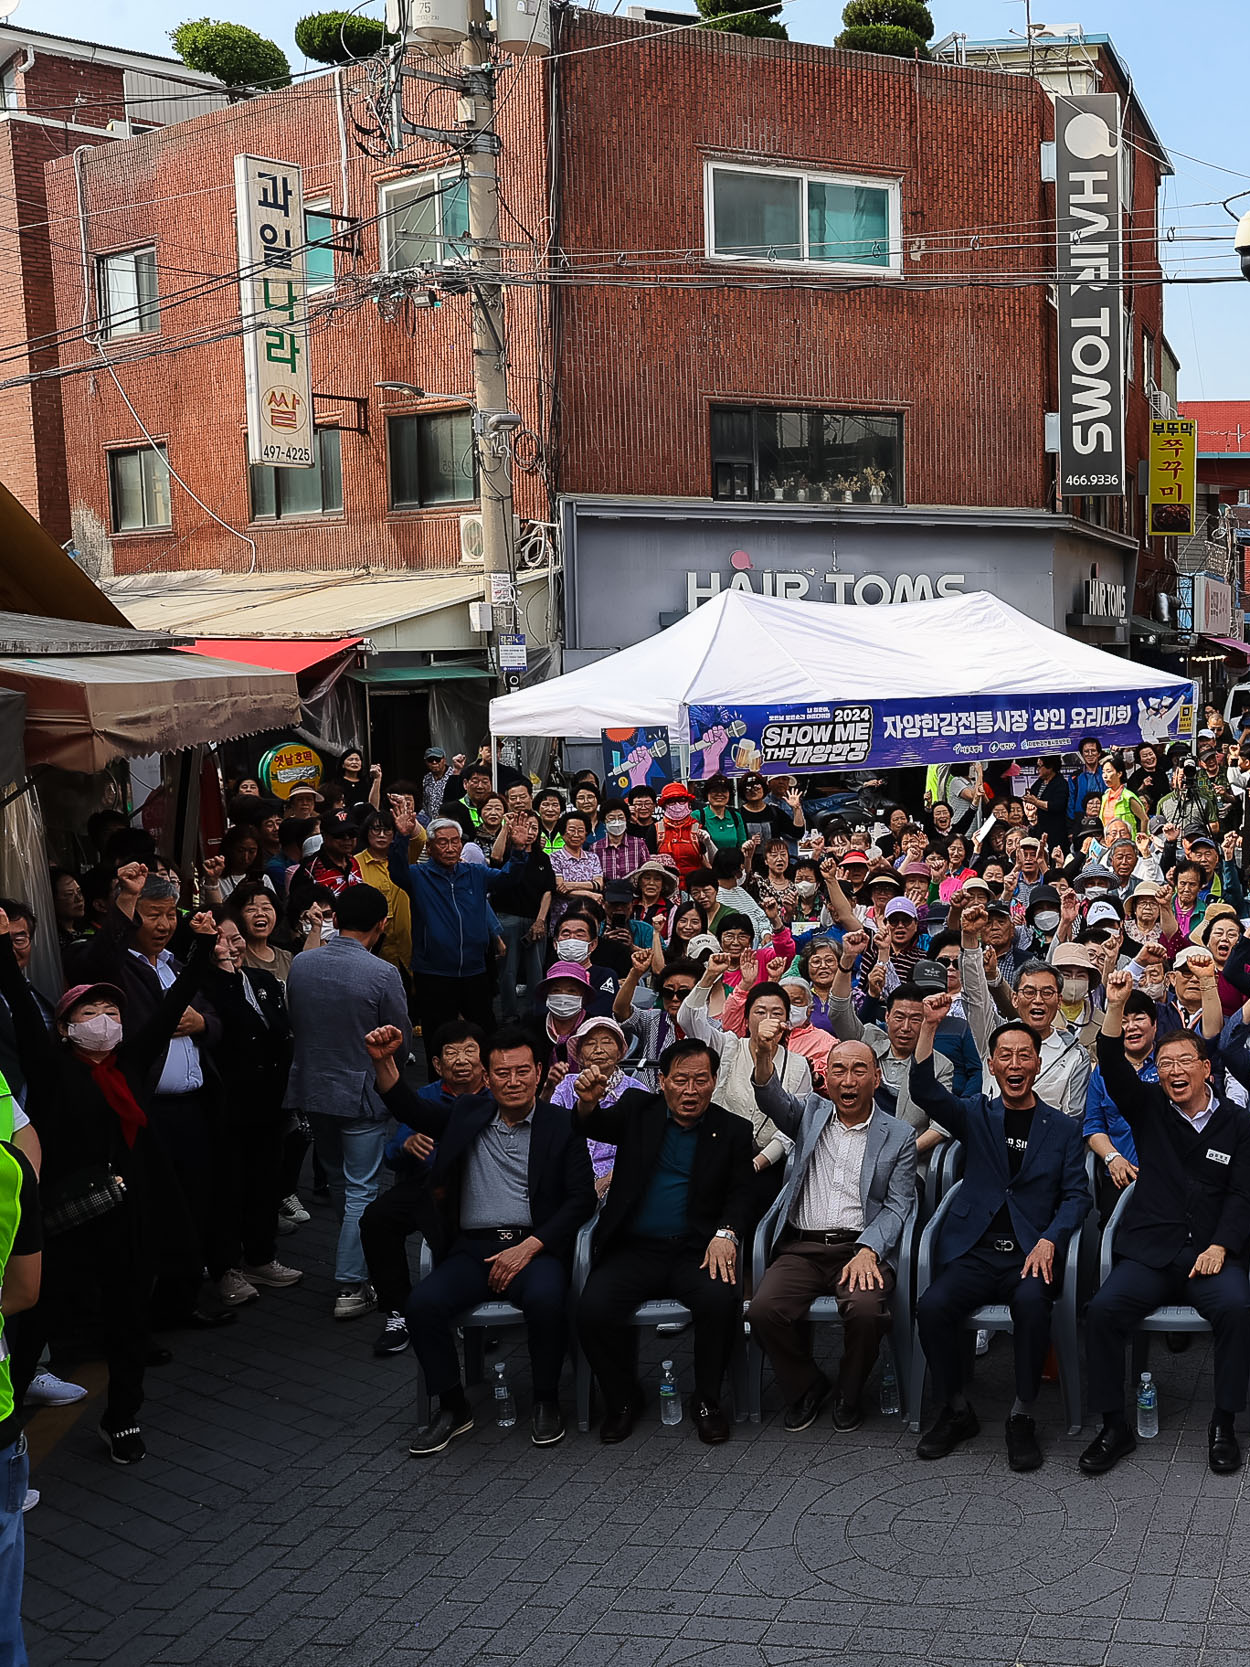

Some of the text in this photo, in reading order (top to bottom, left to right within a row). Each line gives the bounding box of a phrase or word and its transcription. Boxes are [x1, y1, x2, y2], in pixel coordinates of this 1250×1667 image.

[257, 171, 301, 374] 과일나라
[1068, 171, 1113, 455] HAIR TOMS
[268, 390, 300, 429] 쌀
[1152, 422, 1194, 436] 부뚜막
[263, 443, 310, 462] 497-4225
[1066, 473, 1119, 487] 466.9336
[686, 571, 966, 613] HAIR TOMS
[1107, 583, 1126, 618] TOMS
[834, 709, 870, 722] 2024
[883, 704, 1132, 739] 자양한강전통시장 상인 요리대회
[764, 722, 870, 747] SHOW ME
[764, 742, 869, 765] THE 자양한강
